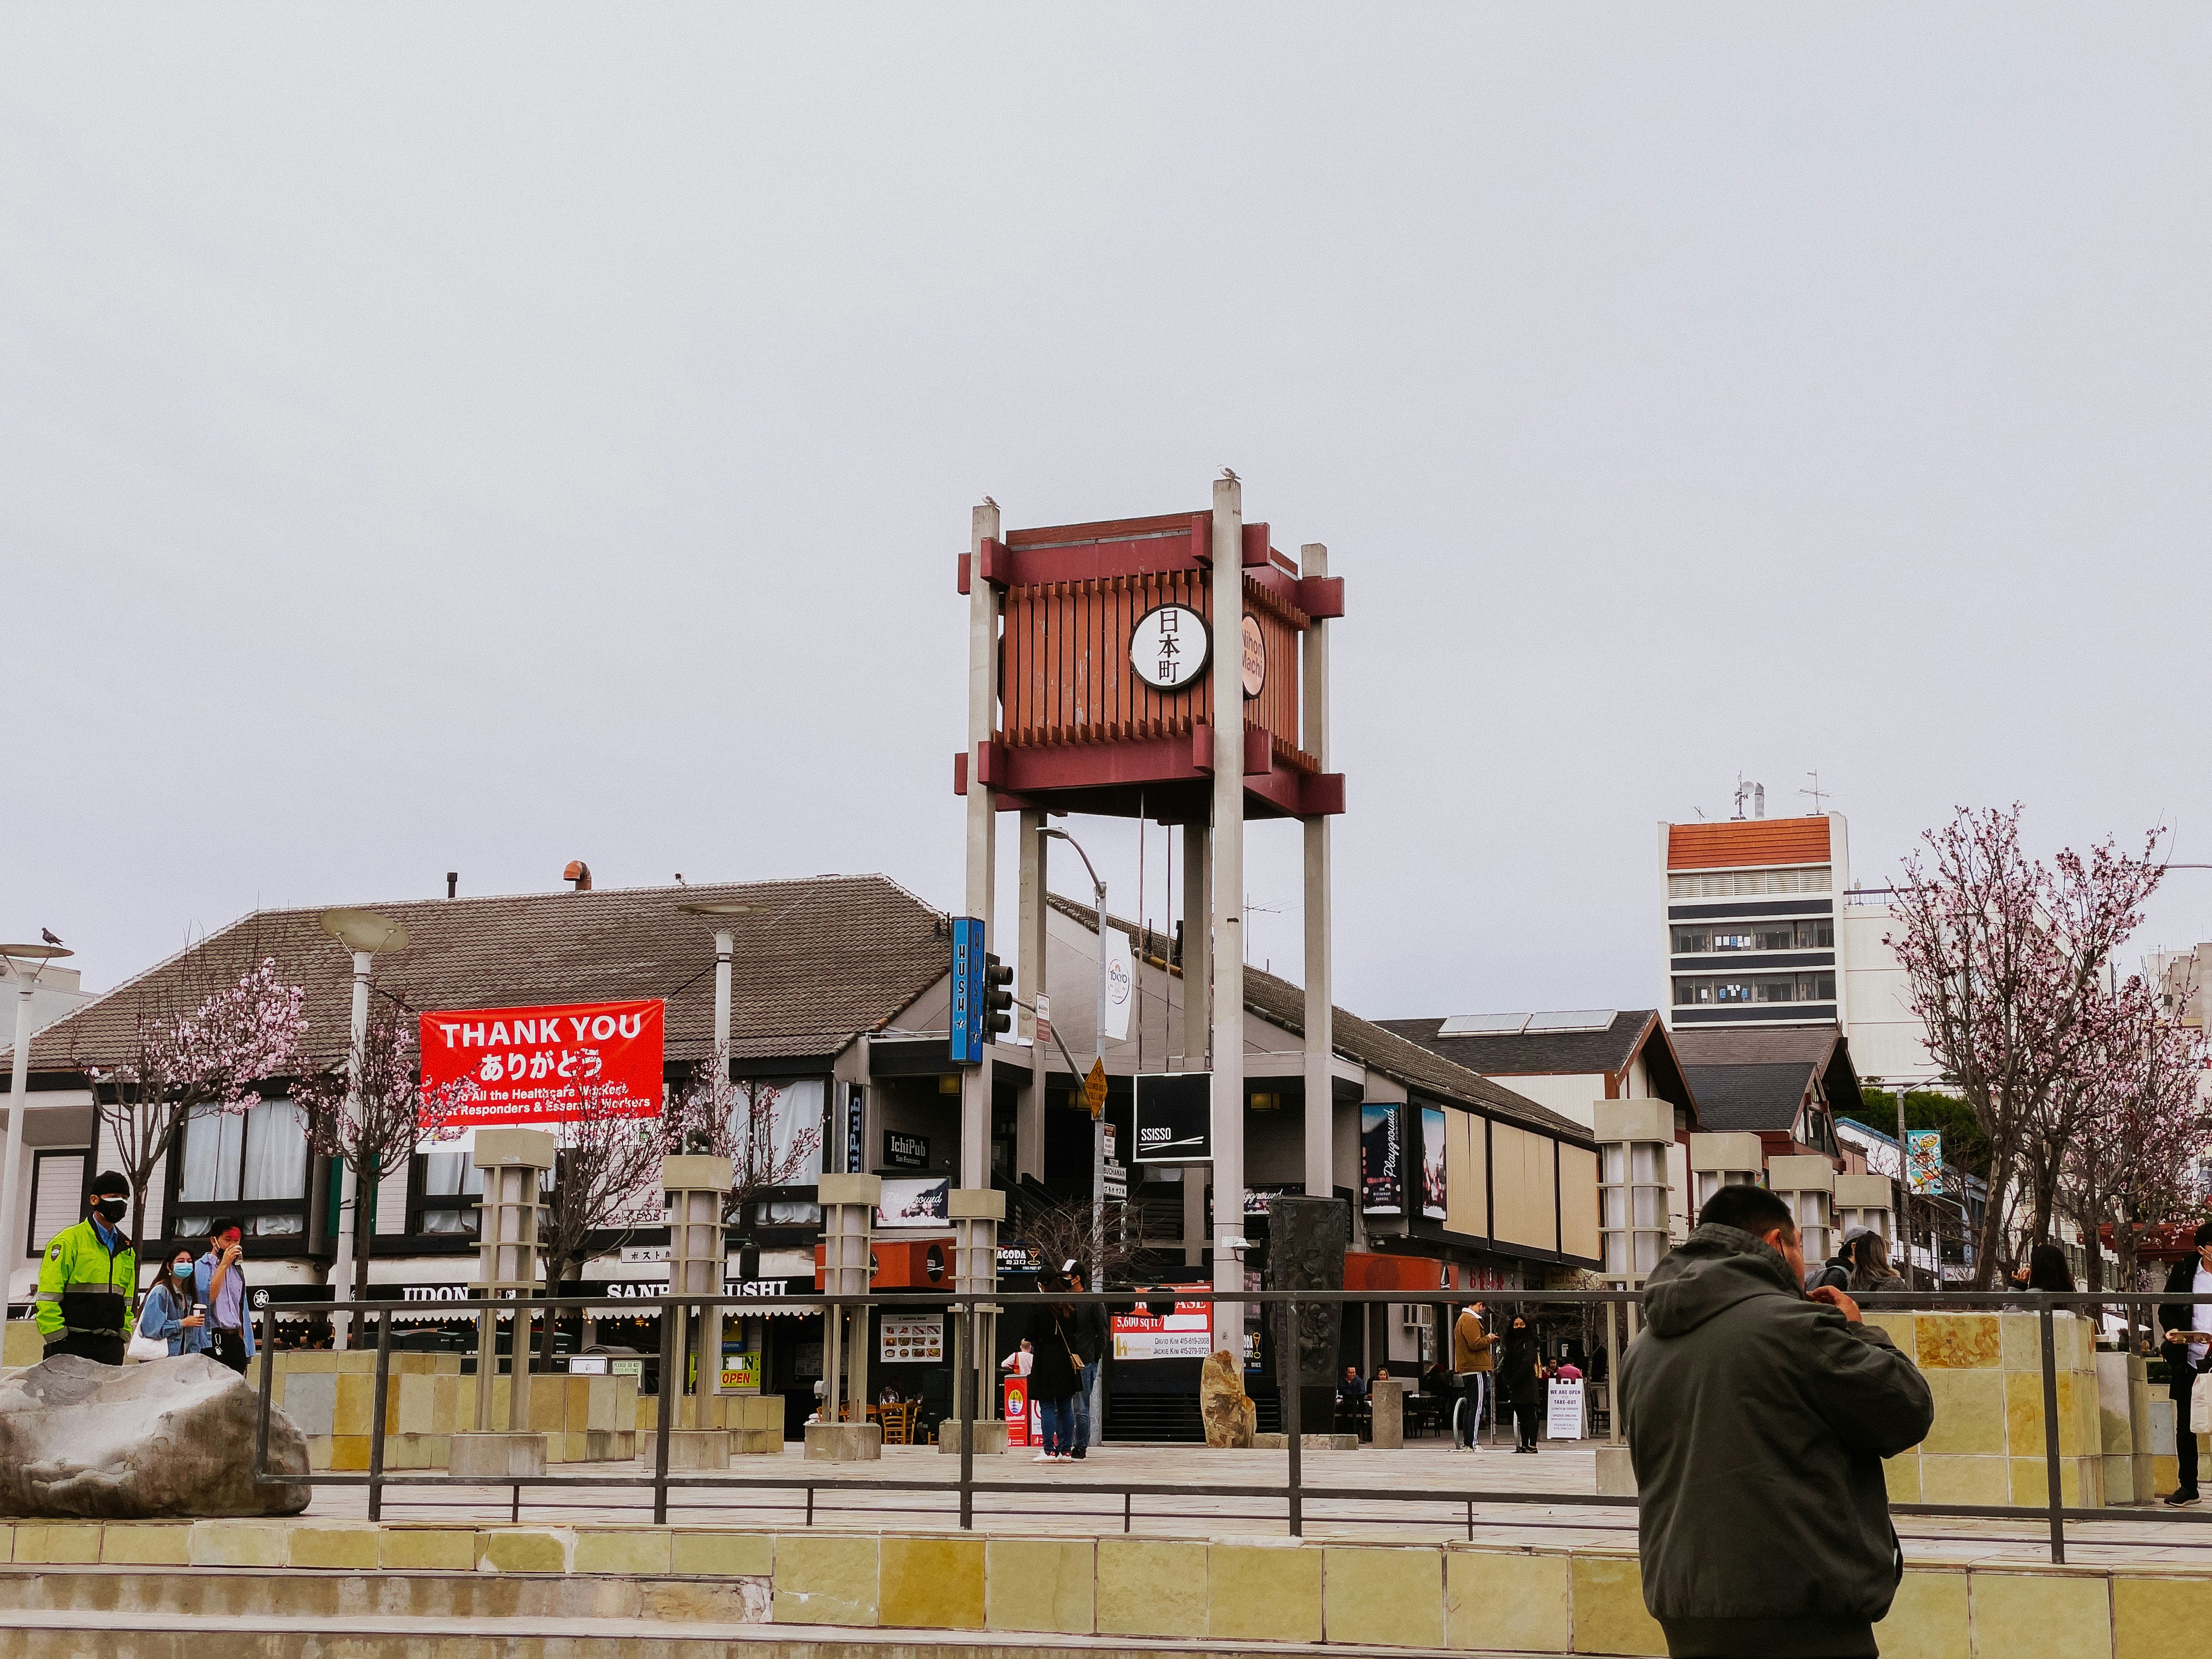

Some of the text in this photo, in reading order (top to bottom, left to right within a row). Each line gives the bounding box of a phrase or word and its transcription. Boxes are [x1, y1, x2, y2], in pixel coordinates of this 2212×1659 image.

[1157, 609, 1181, 684] 日本町
[1242, 629, 1262, 658] Nihon
[1110, 970, 1128, 984] TOKYO
[440, 1014, 641, 1048] THANK YOU
[480, 1048, 603, 1082] ありがとう
[472, 1090, 487, 1102] All
[490, 1090, 508, 1100] the
[461, 1103, 530, 1117] Responders
[534, 1102, 542, 1113] &
[601, 1098, 650, 1109] Workers
[1141, 1127, 1171, 1141] SSISSO
[891, 1136, 926, 1157] IchiPub
[1384, 1109, 1400, 1178] Playground
[903, 1156, 920, 1165] Francisco
[1103, 1167, 1125, 1177] BUCHANAN
[1243, 1188, 1283, 1204] yground
[996, 1250, 1026, 1259] AGODA
[403, 1286, 470, 1301] UDON
[607, 1281, 788, 1298] SANP USHI
[1117, 1316, 1138, 1330] 5,600
[1140, 1318, 1150, 1330] sq
[722, 1372, 750, 1384] OPEN
